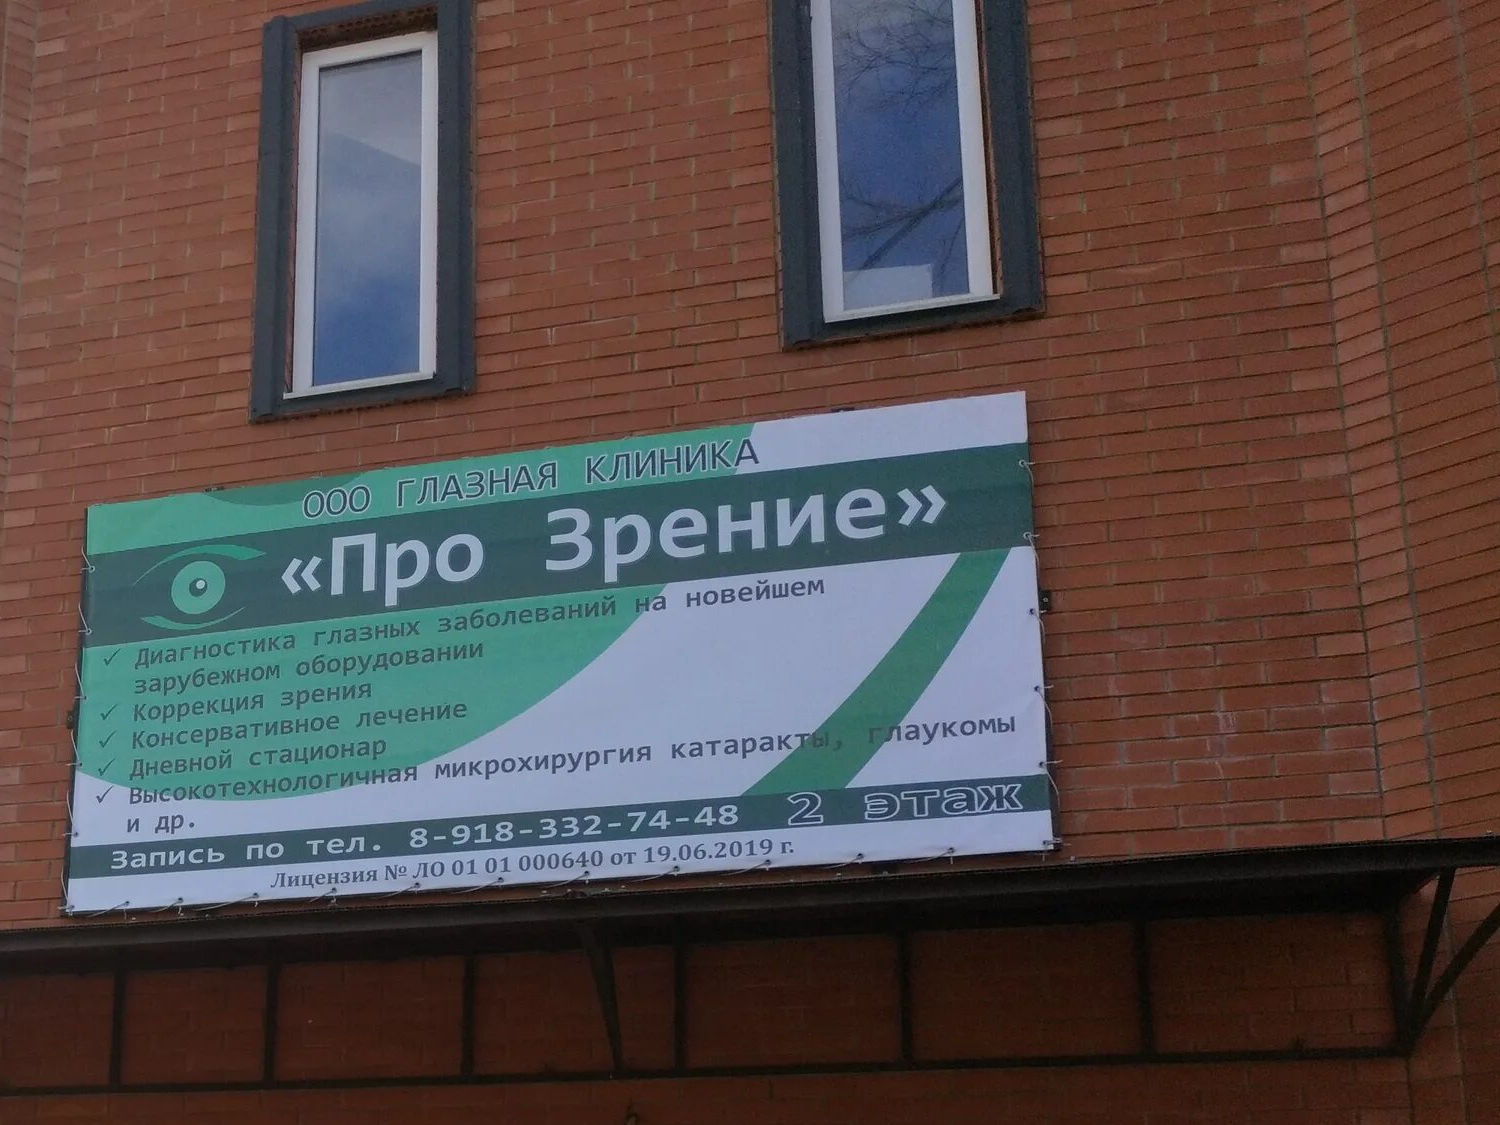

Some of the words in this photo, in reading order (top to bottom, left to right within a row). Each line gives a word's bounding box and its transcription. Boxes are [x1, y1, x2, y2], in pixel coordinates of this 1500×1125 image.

[303, 485, 371, 519] ООО
[396, 461, 558, 508] ГЛАЗНАЯ
[585, 437, 759, 484] КЛИНИКА
[281, 532, 484, 607] «Про
[545, 484, 946, 584] Зрение»
[134, 633, 297, 670] Диагностика
[313, 618, 420, 647] глазных
[438, 597, 616, 634] заболеваний
[635, 594, 667, 614] на
[686, 577, 825, 608] новейшем
[134, 662, 281, 695] зарубежном
[296, 640, 484, 677] оборудовании
[131, 713, 340, 750] Консервативное
[356, 701, 468, 730] лечение
[133, 693, 264, 724] Коррекция
[281, 682, 372, 708] зрения
[129, 750, 233, 780] Дневной
[249, 738, 387, 768] стационар
[129, 763, 419, 805] Высокотехнологичная
[435, 742, 652, 780] микрохирургия
[672, 730, 844, 760] катаракты,
[868, 715, 1016, 749] глаукомы
[126, 816, 140, 832] и
[155, 811, 197, 835] др.
[788, 792, 824, 826] 2
[864, 782, 1022, 821] этаж
[111, 846, 225, 870] Запись
[247, 841, 284, 862] по
[307, 835, 383, 856] тел.
[409, 805, 739, 849] 8-918-332-74-48
[270, 865, 378, 889] Лицензия
[385, 862, 408, 880] №
[414, 860, 446, 879] ЛО
[451, 859, 479, 877] 01
[485, 857, 511, 875] 01
[518, 850, 603, 873] 000640
[610, 849, 637, 866] от
[643, 837, 774, 864] 19.06.2019
[779, 840, 795, 855] г.
